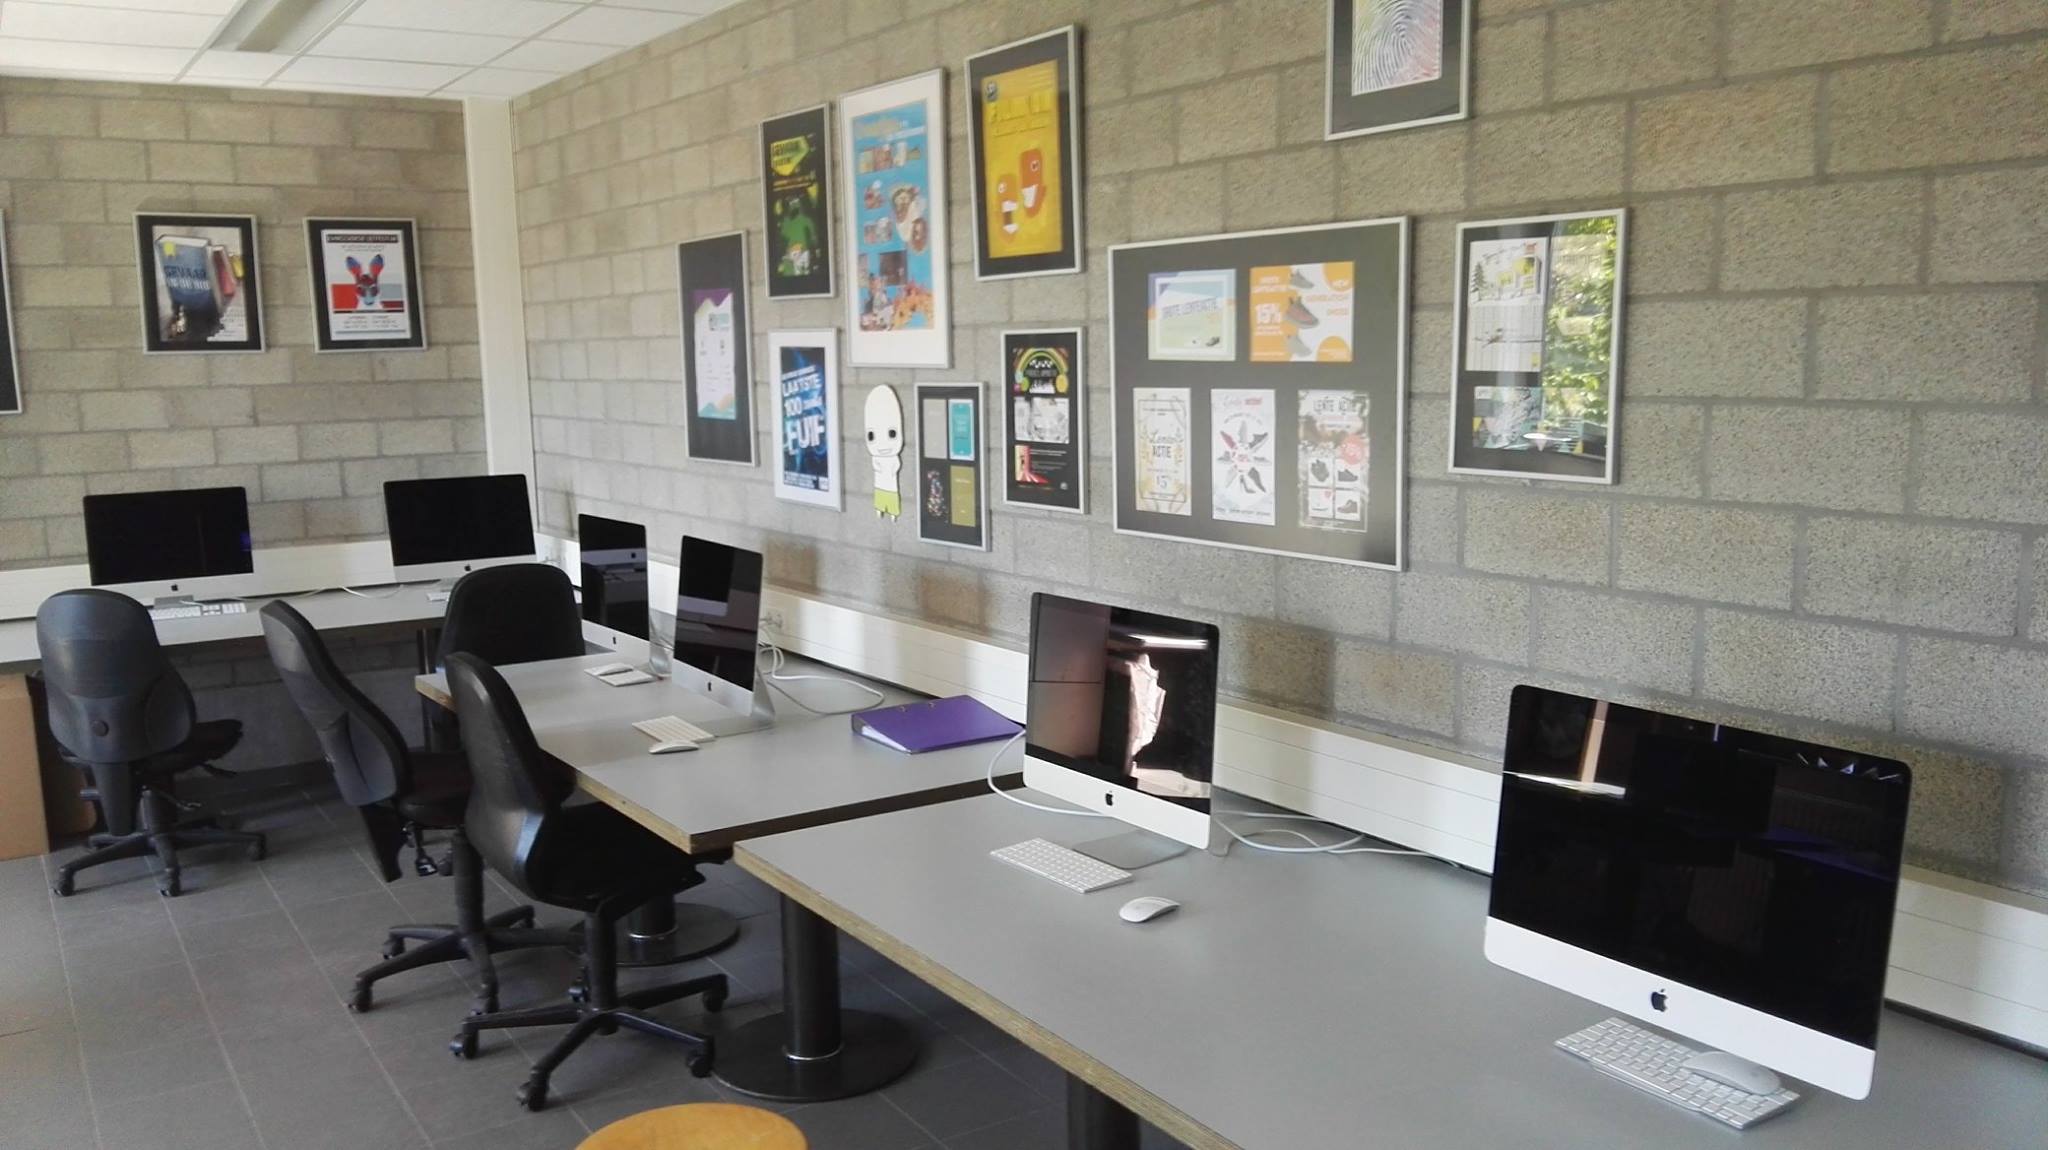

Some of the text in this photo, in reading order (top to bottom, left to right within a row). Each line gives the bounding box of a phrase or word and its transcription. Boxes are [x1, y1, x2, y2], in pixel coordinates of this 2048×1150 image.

[782, 373, 822, 397] LAATSTE
[784, 396, 802, 416] 100
[785, 414, 825, 455] FUIF
